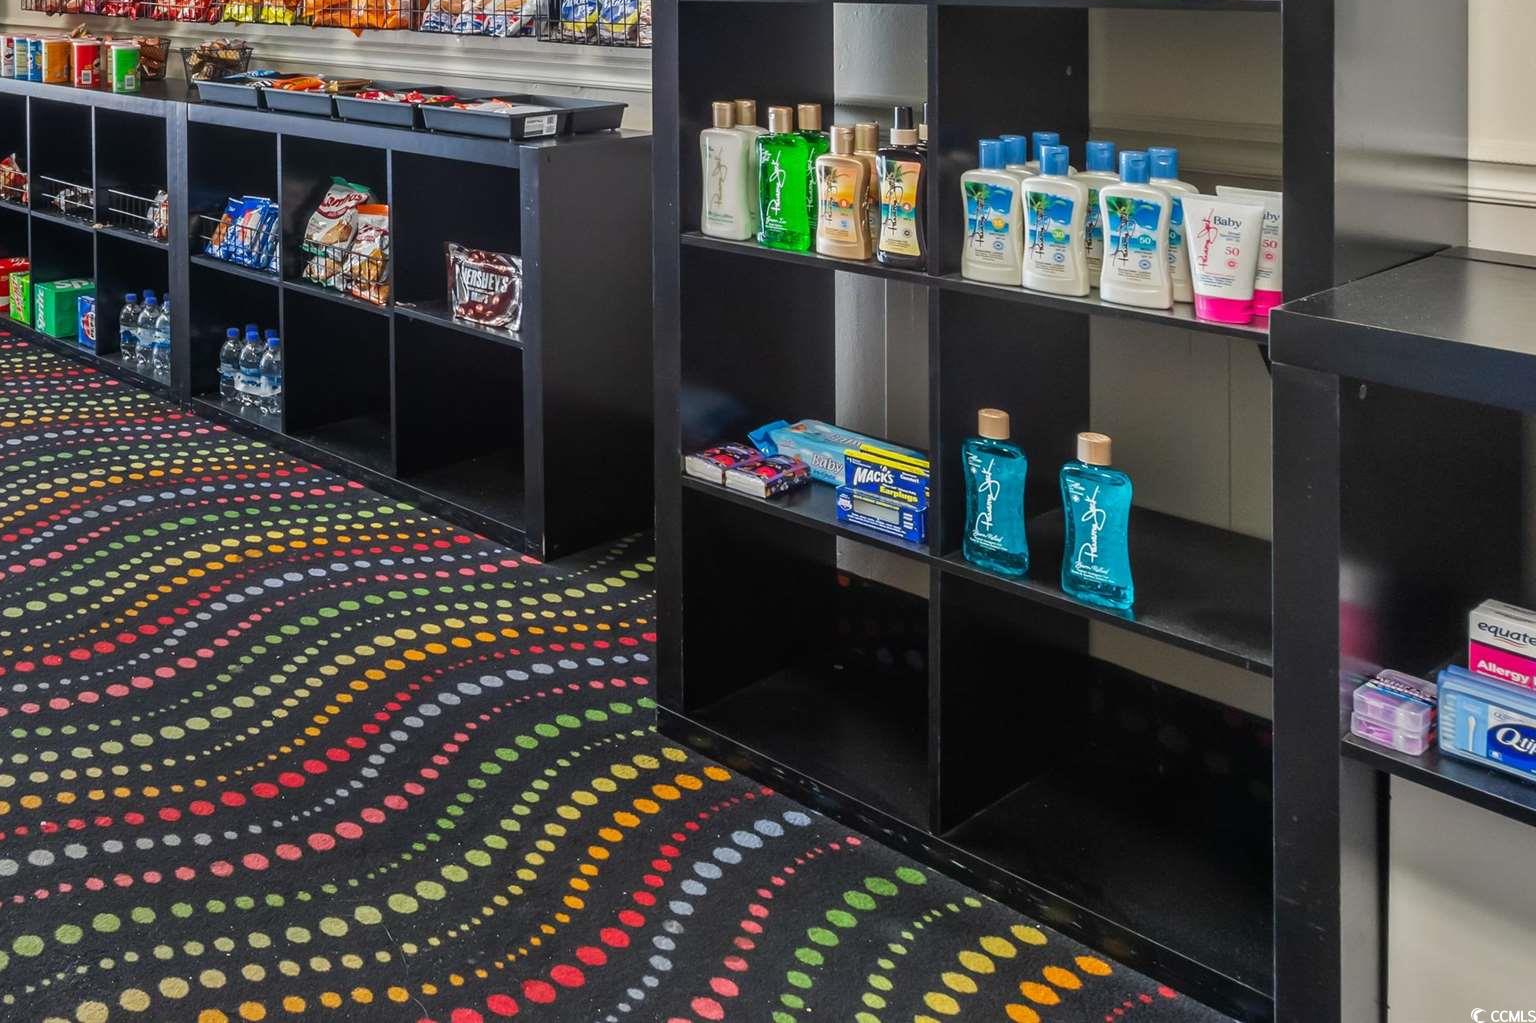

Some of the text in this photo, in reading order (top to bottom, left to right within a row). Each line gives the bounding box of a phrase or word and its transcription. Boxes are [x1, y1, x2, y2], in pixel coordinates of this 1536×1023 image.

[1213, 216, 1242, 230] Baby
[1139, 237, 1151, 245] 50
[1263, 238, 1278, 249] 50
[1225, 246, 1240, 257] 50
[812, 453, 844, 476] Baby
[879, 486, 918, 503] Earplugs
[1477, 622, 1536, 647] equate
[1477, 660, 1530, 685] Allergy
